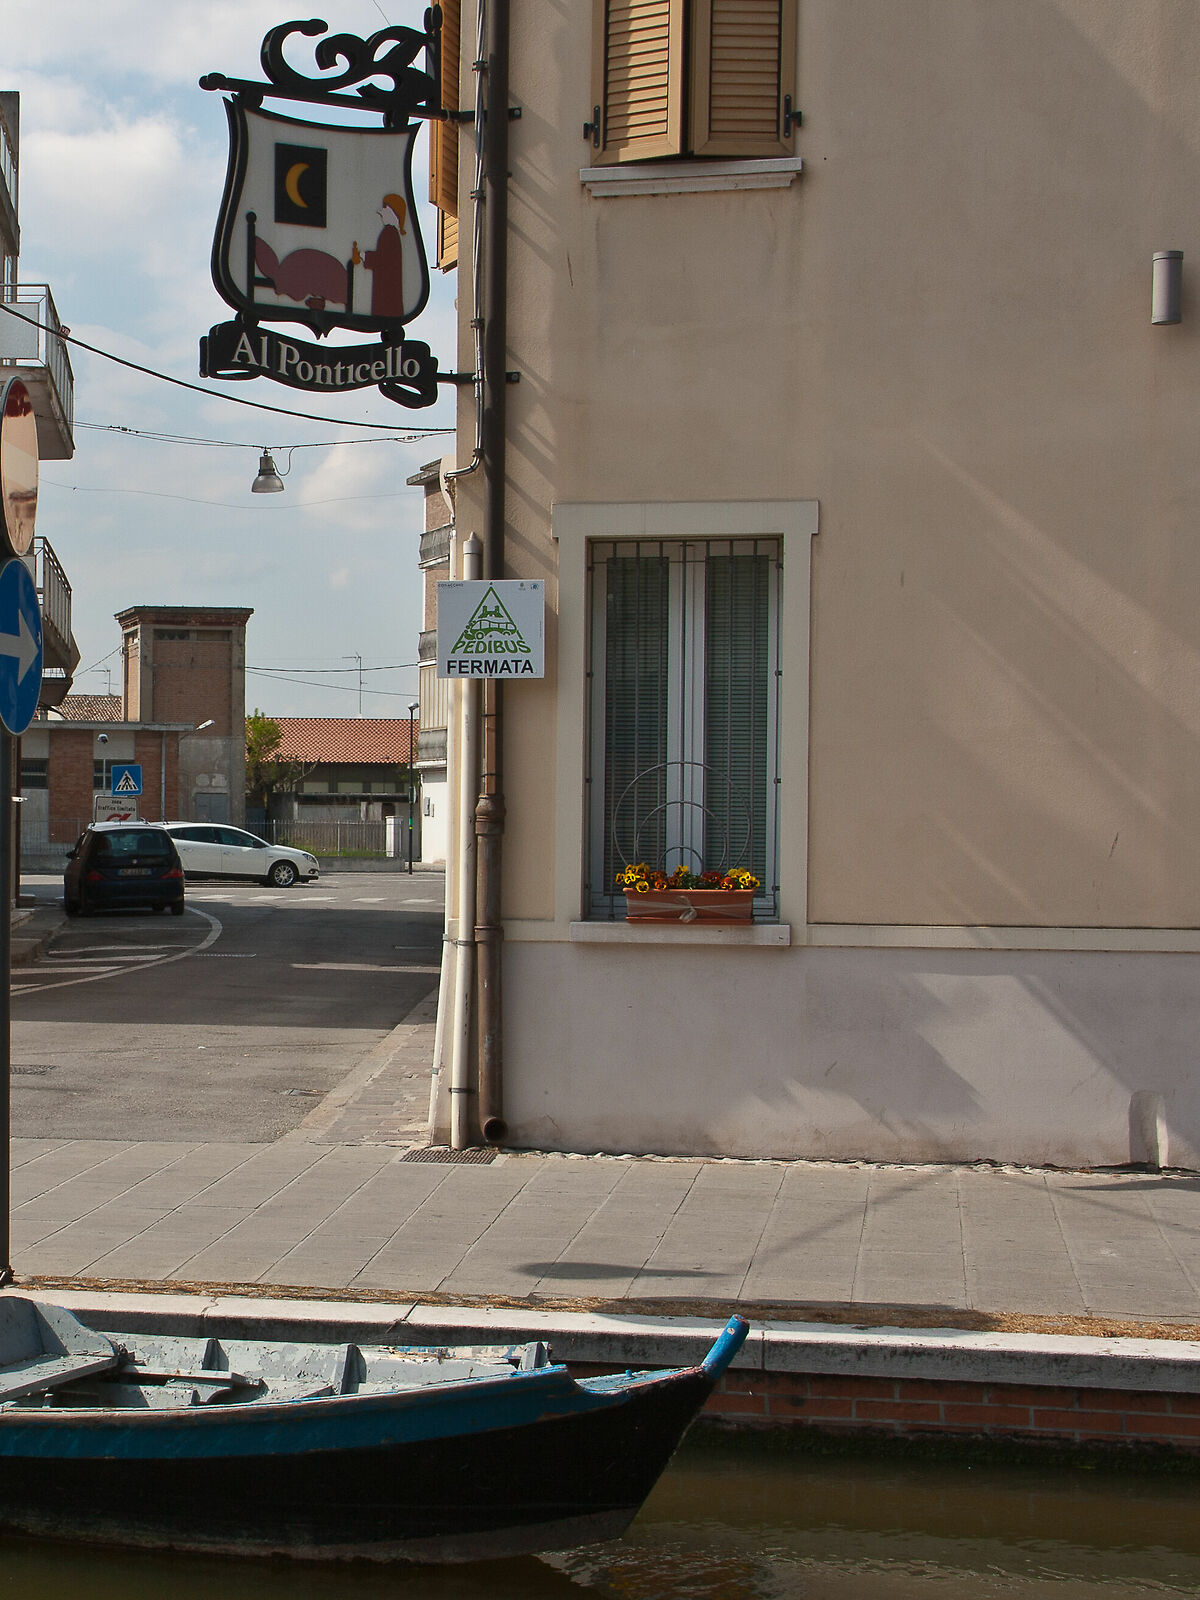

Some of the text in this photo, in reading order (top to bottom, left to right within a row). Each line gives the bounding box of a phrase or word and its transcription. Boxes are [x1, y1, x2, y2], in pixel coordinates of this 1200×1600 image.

[231, 331, 421, 386] Al Ponticello
[450, 640, 532, 655] PEDIBUS
[446, 659, 535, 675] FERMATA
